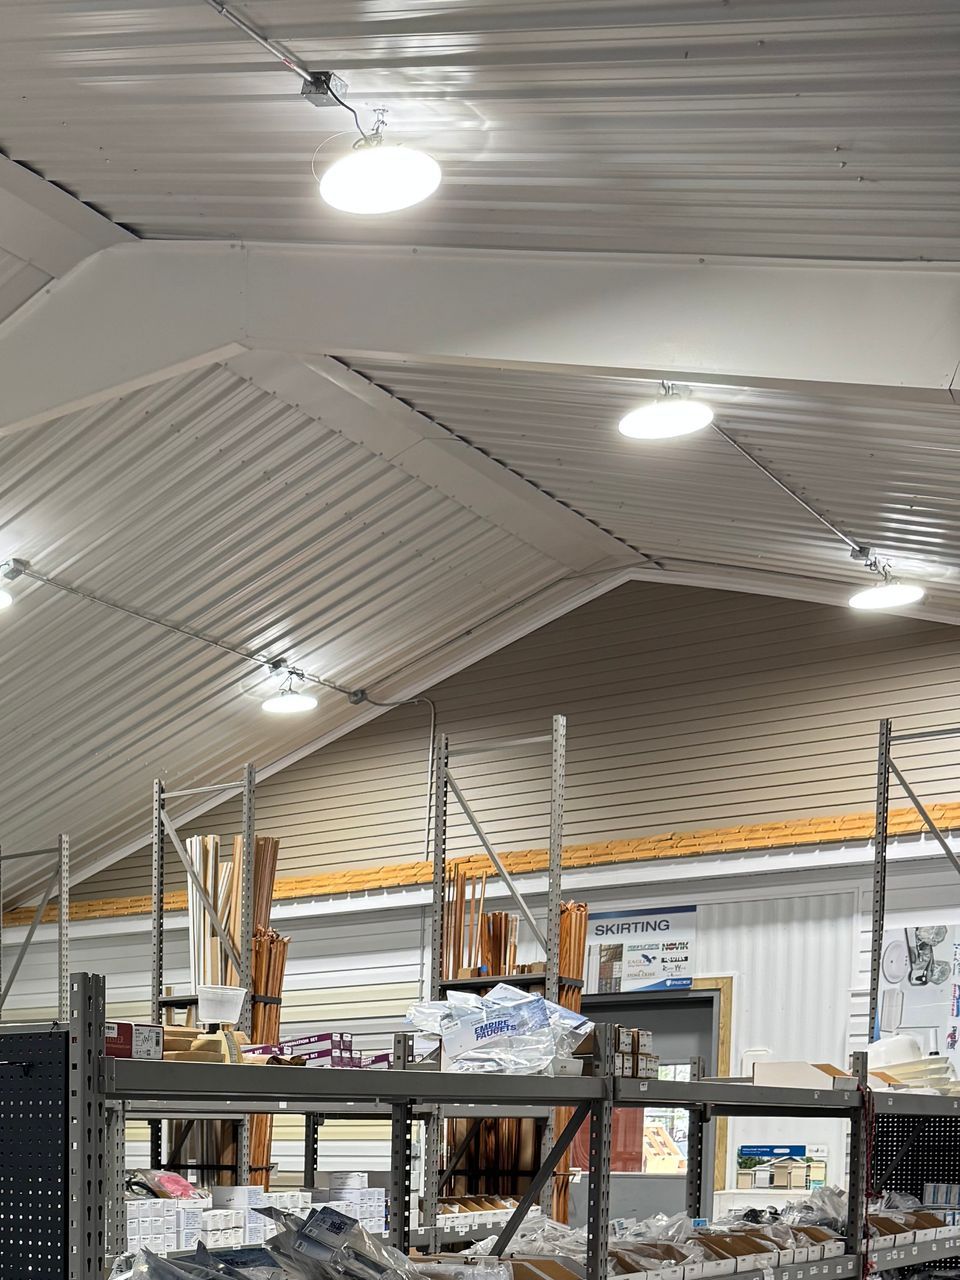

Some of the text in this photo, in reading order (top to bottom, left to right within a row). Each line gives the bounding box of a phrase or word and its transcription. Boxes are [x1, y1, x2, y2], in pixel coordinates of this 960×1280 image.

[595, 919, 670, 936] SKIRTING
[661, 942, 689, 951] NOVIK
[474, 1019, 510, 1035] EMPIRE
[475, 1024, 517, 1041] FAUCETS
